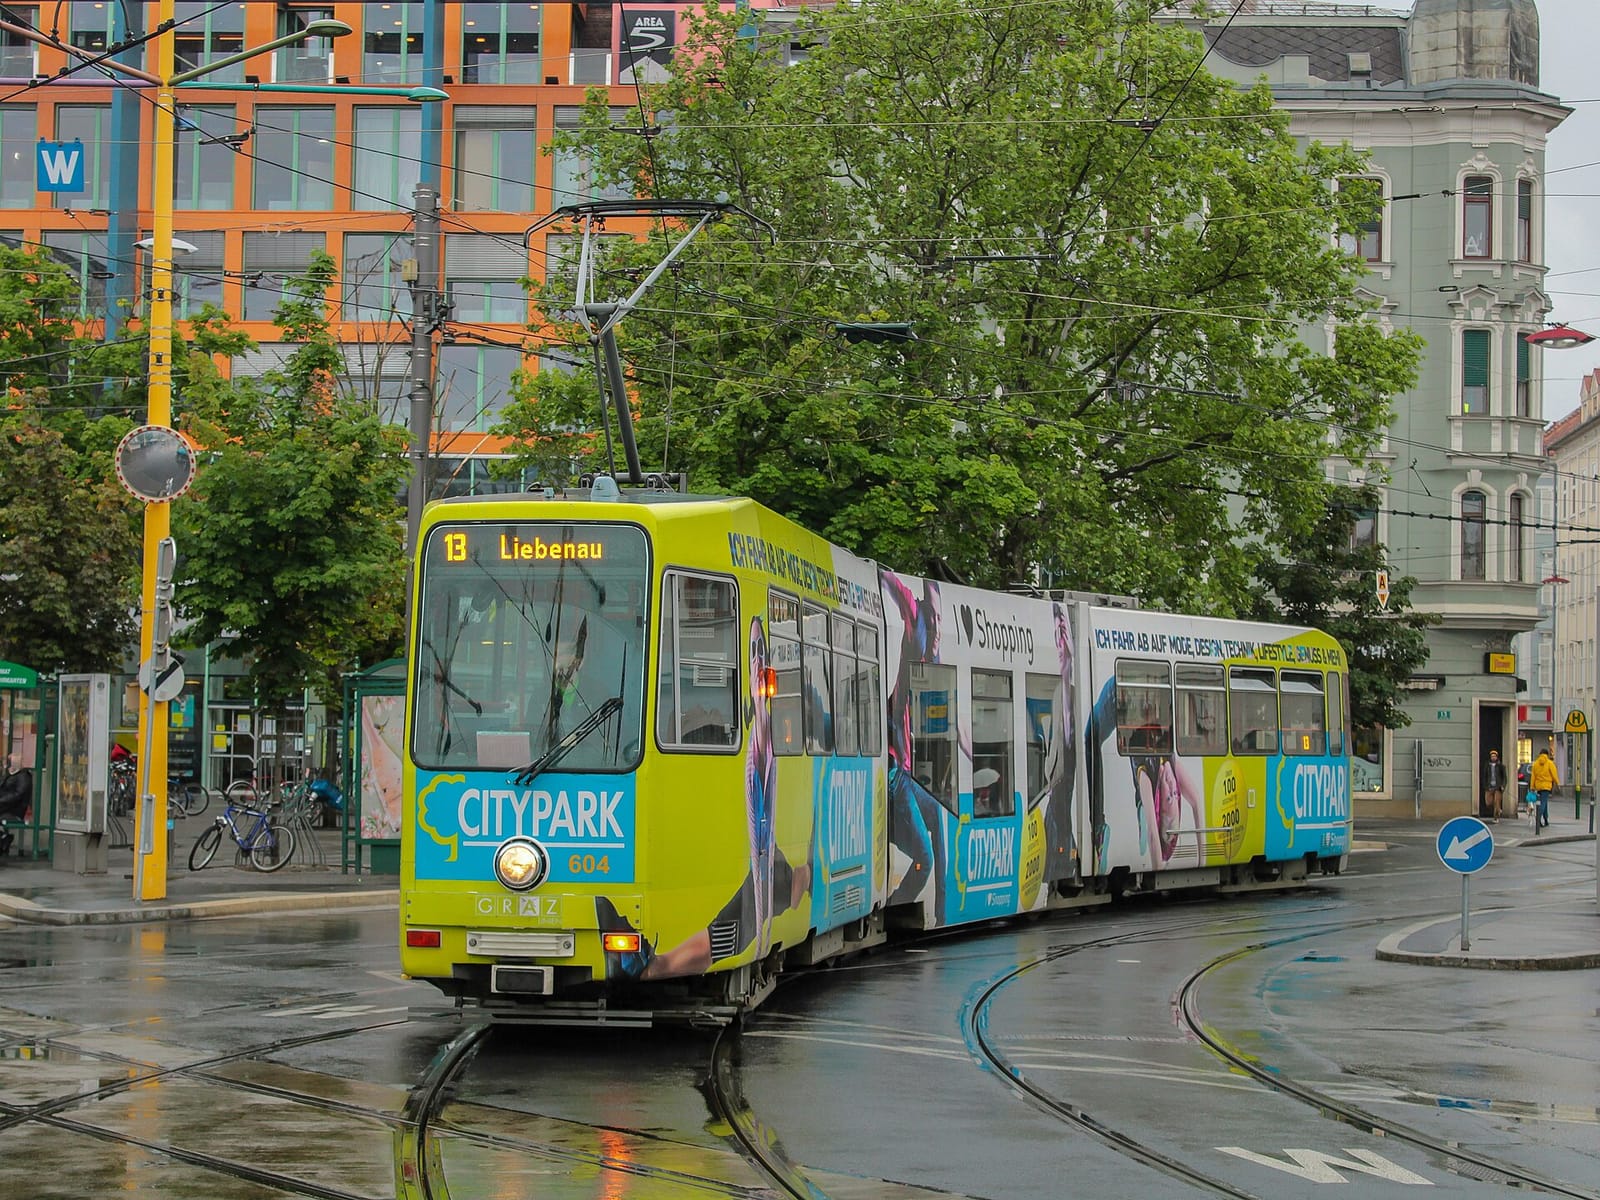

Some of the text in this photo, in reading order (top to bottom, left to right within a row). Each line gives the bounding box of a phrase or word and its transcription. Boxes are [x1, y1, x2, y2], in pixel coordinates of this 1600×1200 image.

[635, 17, 664, 27] AREA
[630, 27, 666, 51] 5
[41, 150, 80, 184] W
[444, 533, 602, 561] 13 Liebenau
[953, 604, 1034, 666] I Shopping
[1095, 628, 1111, 649] ICH
[1111, 630, 1136, 651] FAHR
[1137, 633, 1150, 652] AB
[1151, 634, 1167, 654] AUF
[1168, 635, 1195, 659] MODE,
[1223, 777, 1237, 796] 100
[458, 788, 624, 837] CITYPARK
[829, 768, 867, 864] CITYPARK
[568, 854, 610, 874] 604
[968, 827, 1015, 882] CITYPARK
[478, 898, 558, 914] GRAZ
